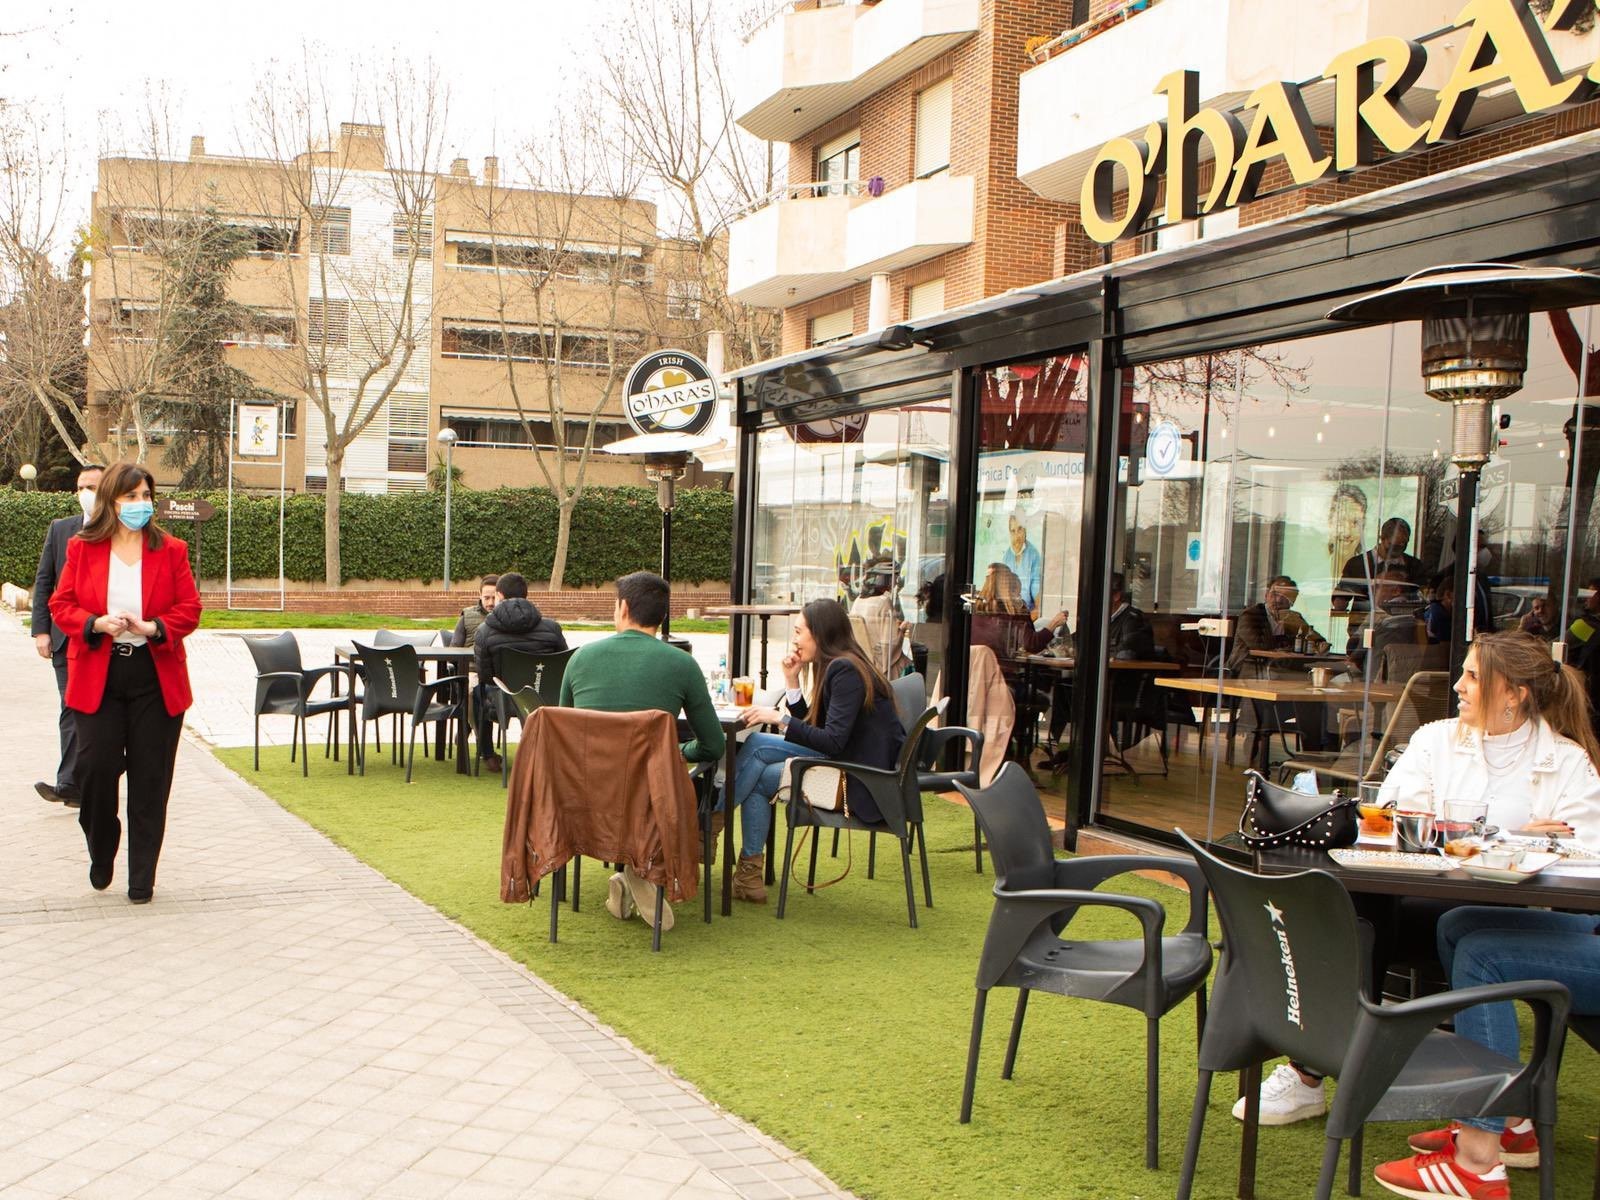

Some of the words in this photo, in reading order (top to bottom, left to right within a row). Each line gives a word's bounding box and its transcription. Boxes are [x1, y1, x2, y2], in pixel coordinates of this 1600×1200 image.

[659, 357, 684, 366] IRISH
[170, 500, 195, 511] Paschi
[1277, 928, 1300, 1026] Heineken
